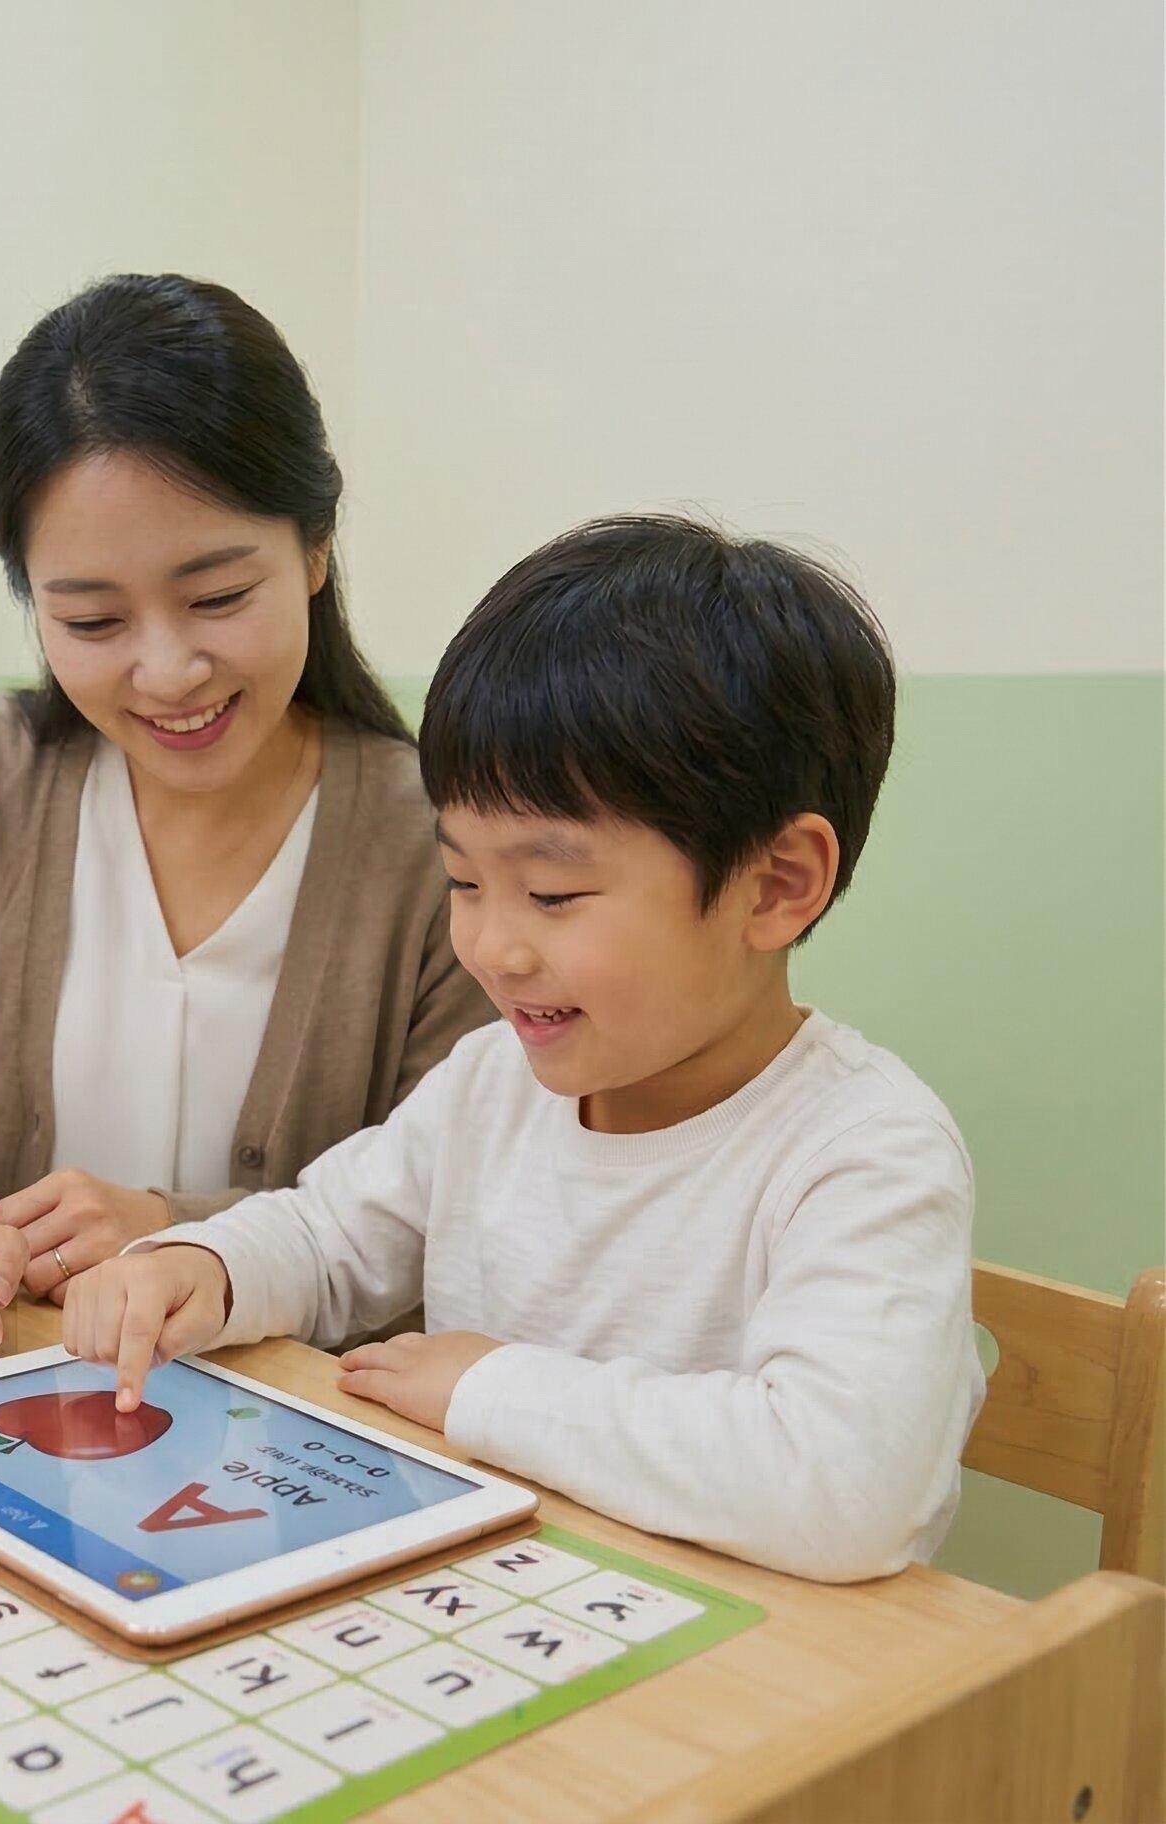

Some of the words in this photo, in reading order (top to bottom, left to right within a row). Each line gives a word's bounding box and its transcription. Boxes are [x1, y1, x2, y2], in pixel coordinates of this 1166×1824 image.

[222, 1460, 328, 1506] Apple
[137, 1482, 268, 1533] A
[403, 1585, 479, 1617] xy
[504, 1630, 563, 1658] w
[36, 1662, 87, 1679] f
[216, 1657, 288, 1695] ki
[110, 1696, 184, 1724] j
[10, 1744, 63, 1773] a
